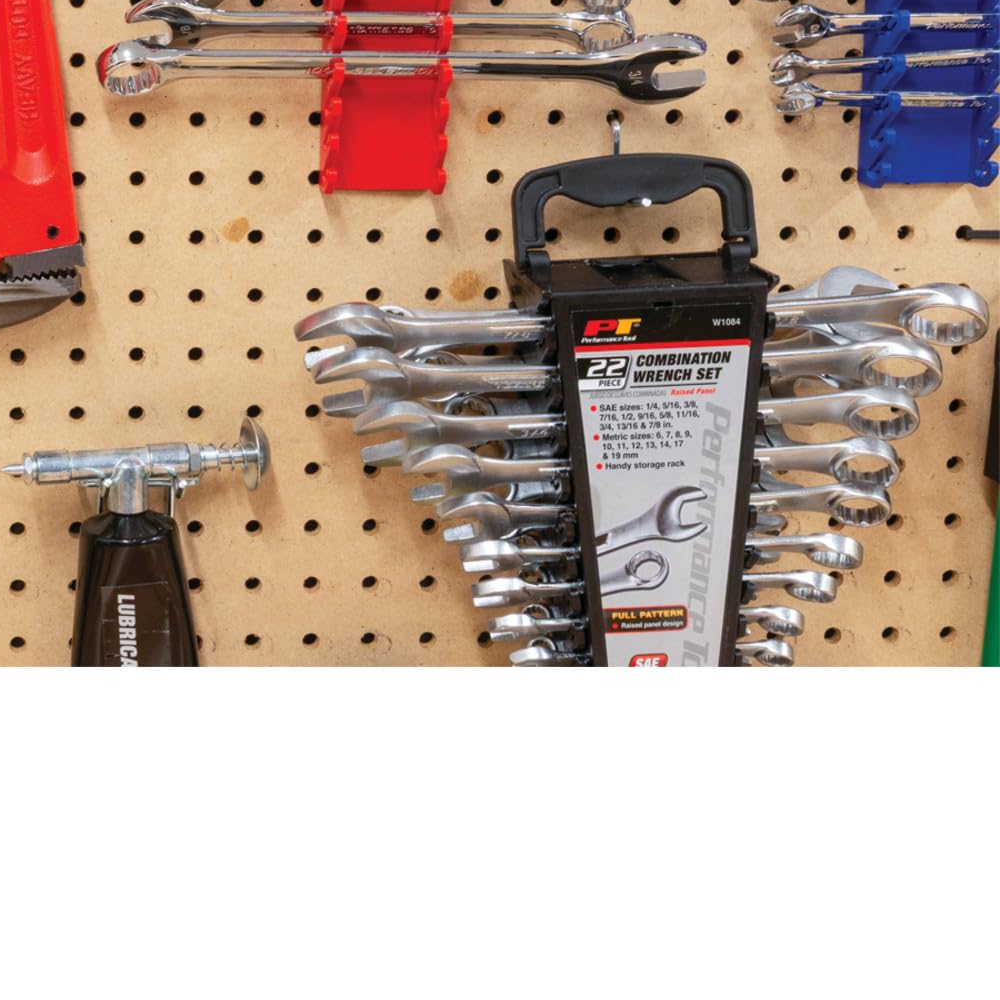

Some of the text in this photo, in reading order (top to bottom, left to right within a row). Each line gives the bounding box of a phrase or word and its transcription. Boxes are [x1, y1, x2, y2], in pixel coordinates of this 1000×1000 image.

[584, 318, 642, 336] PT
[712, 318, 741, 327] W1084
[636, 351, 731, 366] COMBINATION
[586, 359, 624, 377] 22
[633, 367, 723, 384] WRENCH SET
[599, 379, 621, 387] PIECE
[646, 402, 659, 410] 1/4,
[663, 402, 682, 410] 5/16,
[684, 401, 698, 409] 3/8,
[600, 410, 700, 422] 7/16, 1/2, 9/16, 5/8, 11/16,
[600, 423, 614, 431] 3/4,
[616, 422, 638, 430] 13/16
[649, 421, 662, 429] 7/8
[602, 433, 628, 441] Metric
[656, 432, 664, 440] 6,
[675, 431, 682, 439] 8,
[685, 431, 692, 439] 9,
[602, 443, 614, 451] 10,
[631, 442, 643, 450] 12,
[660, 441, 672, 449] 14,
[605, 462, 631, 471] Handy
[634, 461, 665, 470] storage
[687, 402, 731, 634] Performance
[612, 610, 683, 620] FULL PATTERN
[662, 620, 684, 628] design
[117, 594, 138, 667] LUBRICA
